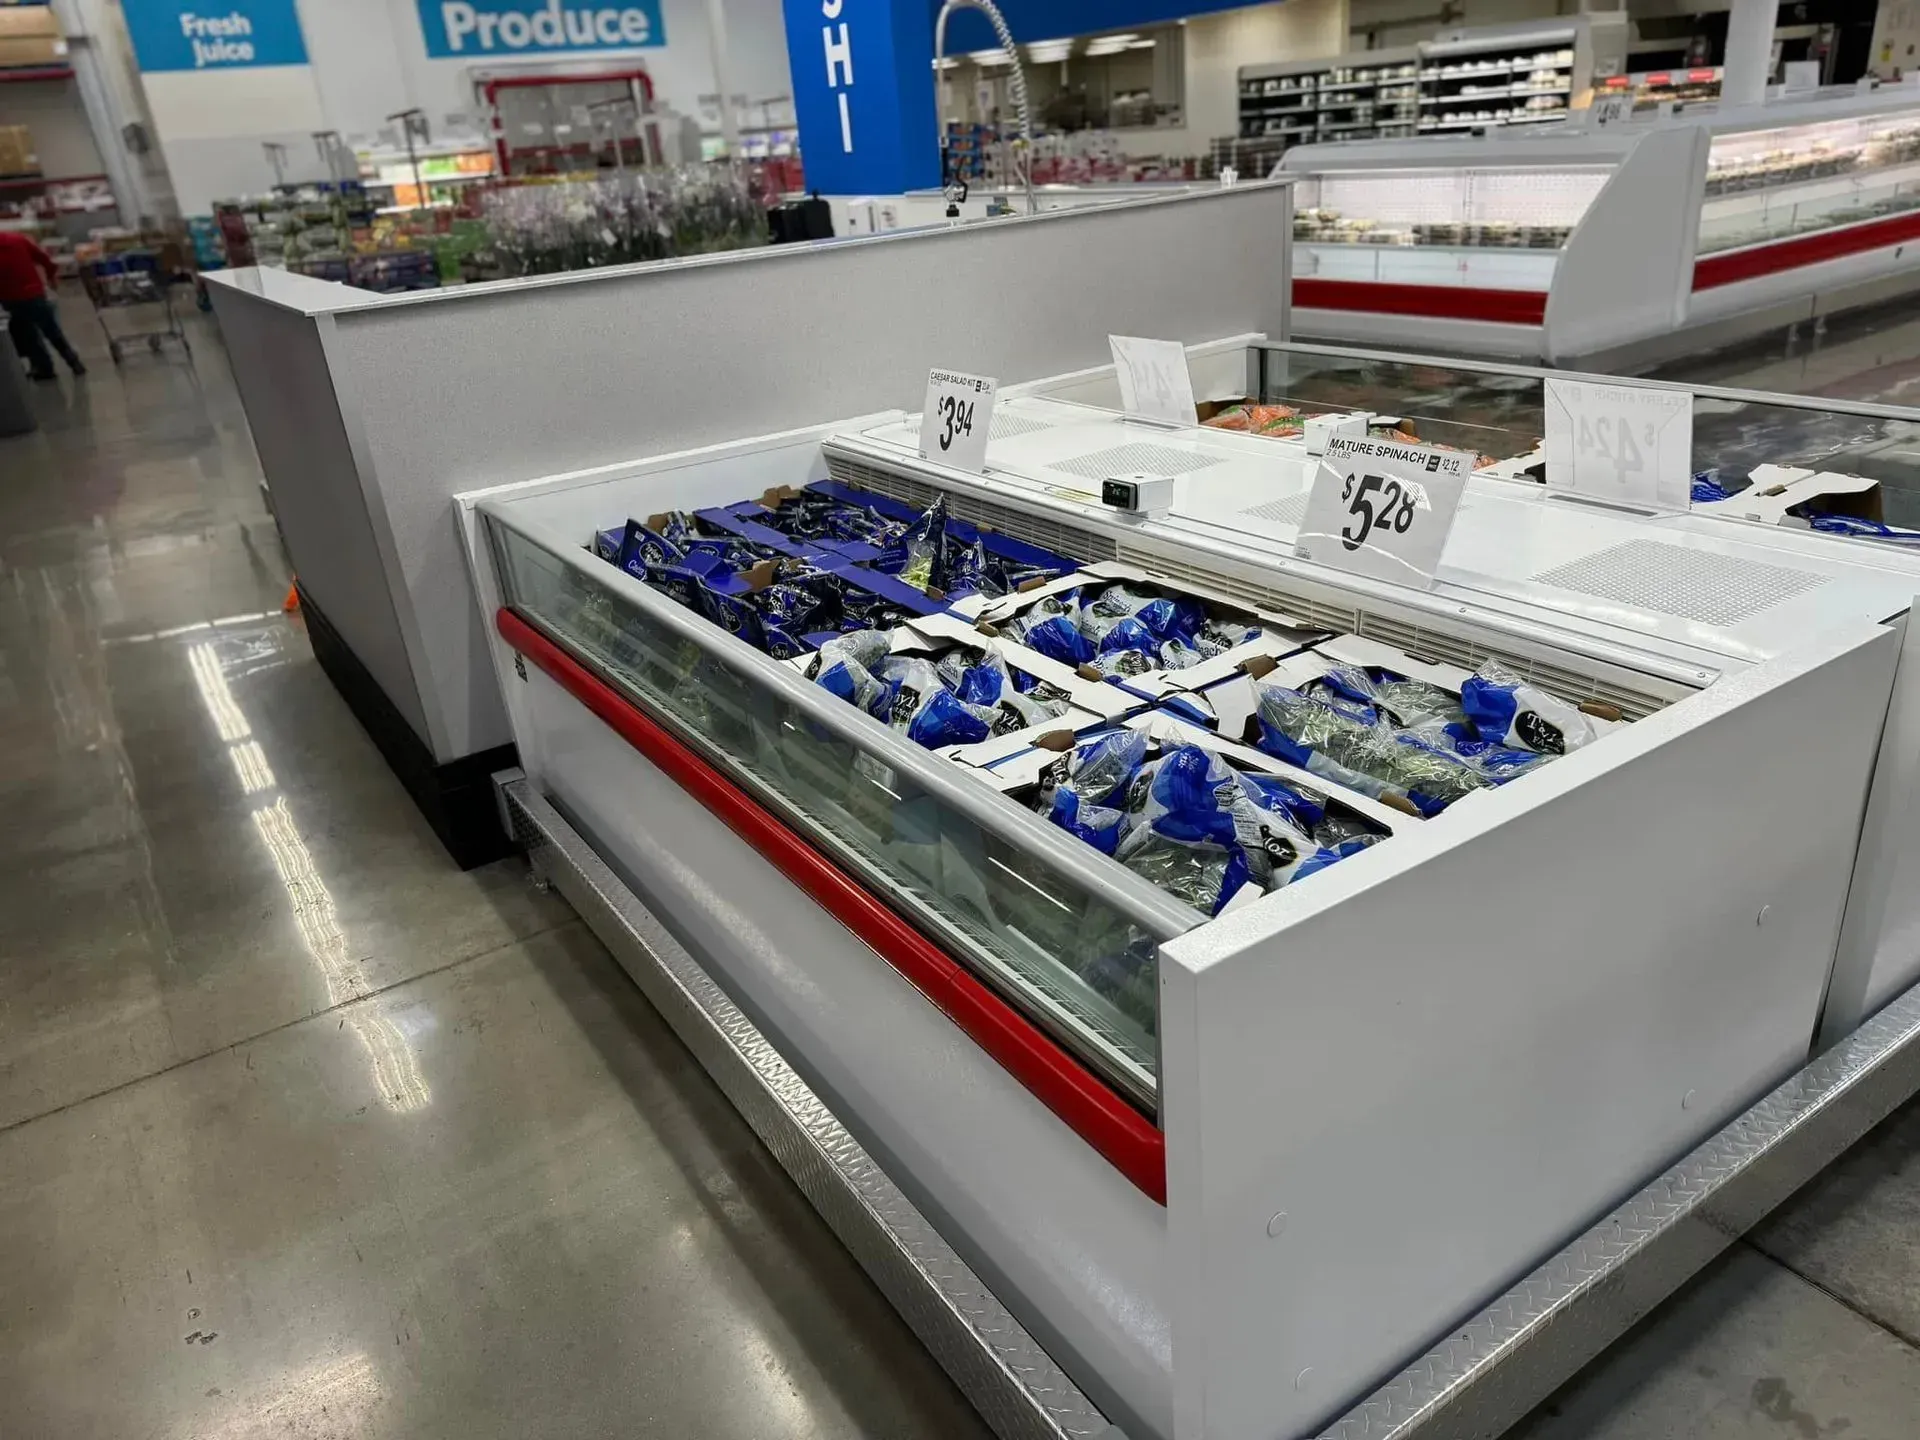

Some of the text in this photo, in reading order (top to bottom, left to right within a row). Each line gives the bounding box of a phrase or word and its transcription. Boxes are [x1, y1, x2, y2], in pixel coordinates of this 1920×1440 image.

[180, 11, 252, 37] Fresh
[441, 0, 649, 50] Produce
[191, 38, 255, 67] Juice
[931, 371, 950, 382] CAESAR
[950, 375, 967, 385] SALAD
[967, 379, 976, 387] KIT
[1329, 438, 1375, 455] MATURE
[1375, 445, 1427, 464] SPINACH
[1337, 451, 1351, 460] LBS
